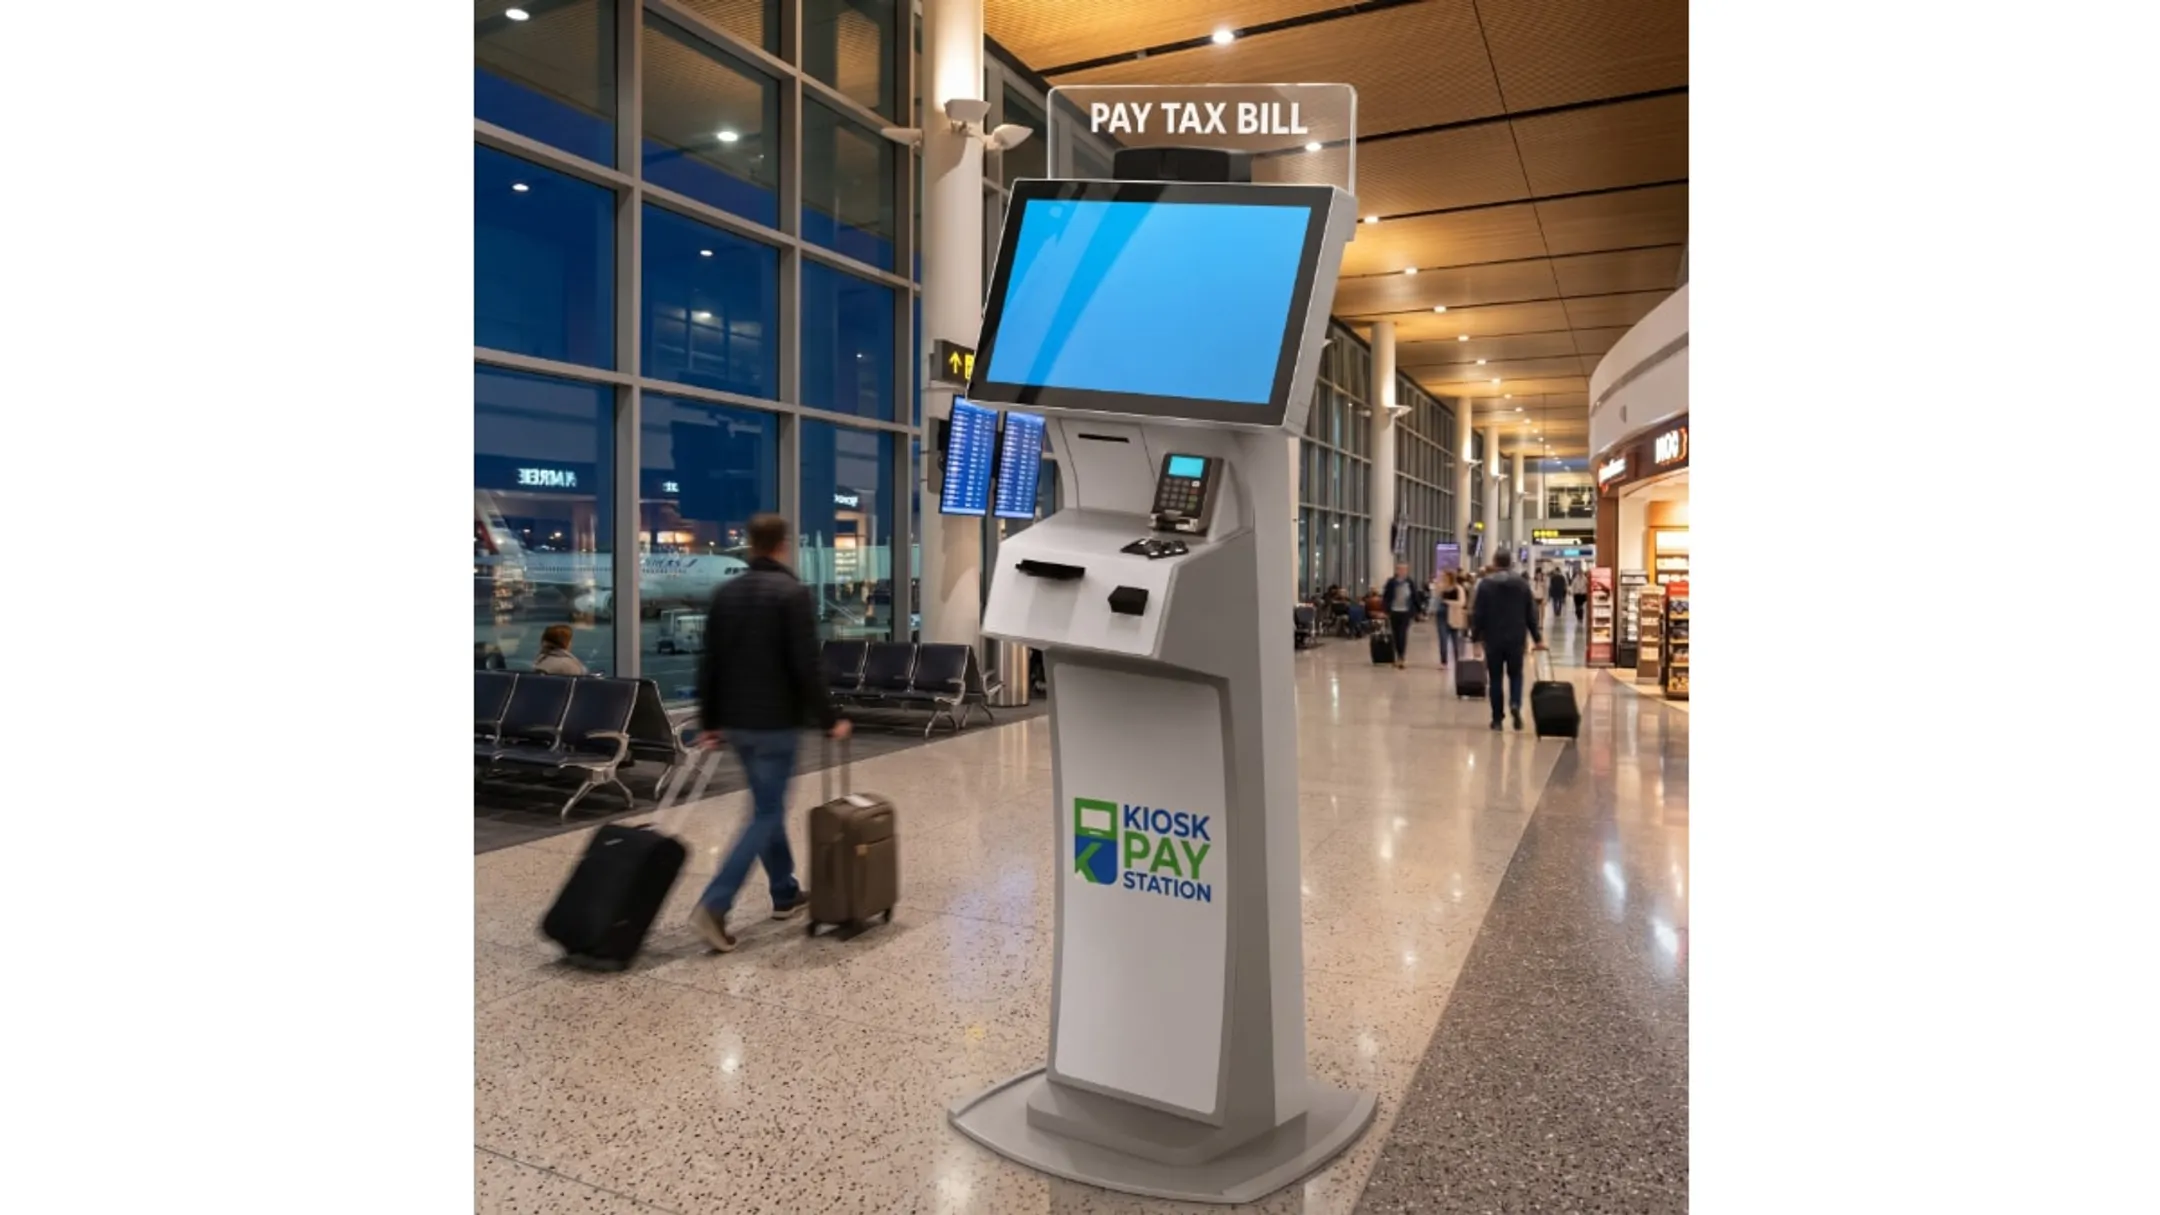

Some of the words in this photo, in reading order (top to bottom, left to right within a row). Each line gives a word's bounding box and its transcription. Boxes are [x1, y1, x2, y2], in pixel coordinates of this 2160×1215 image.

[1090, 102, 1153, 134] PAY
[1160, 102, 1227, 134] TAX
[1237, 102, 1308, 135] BILL
[1123, 804, 1211, 841] KIOSK
[1123, 830, 1211, 880] PAY
[1123, 871, 1211, 903] STATION
